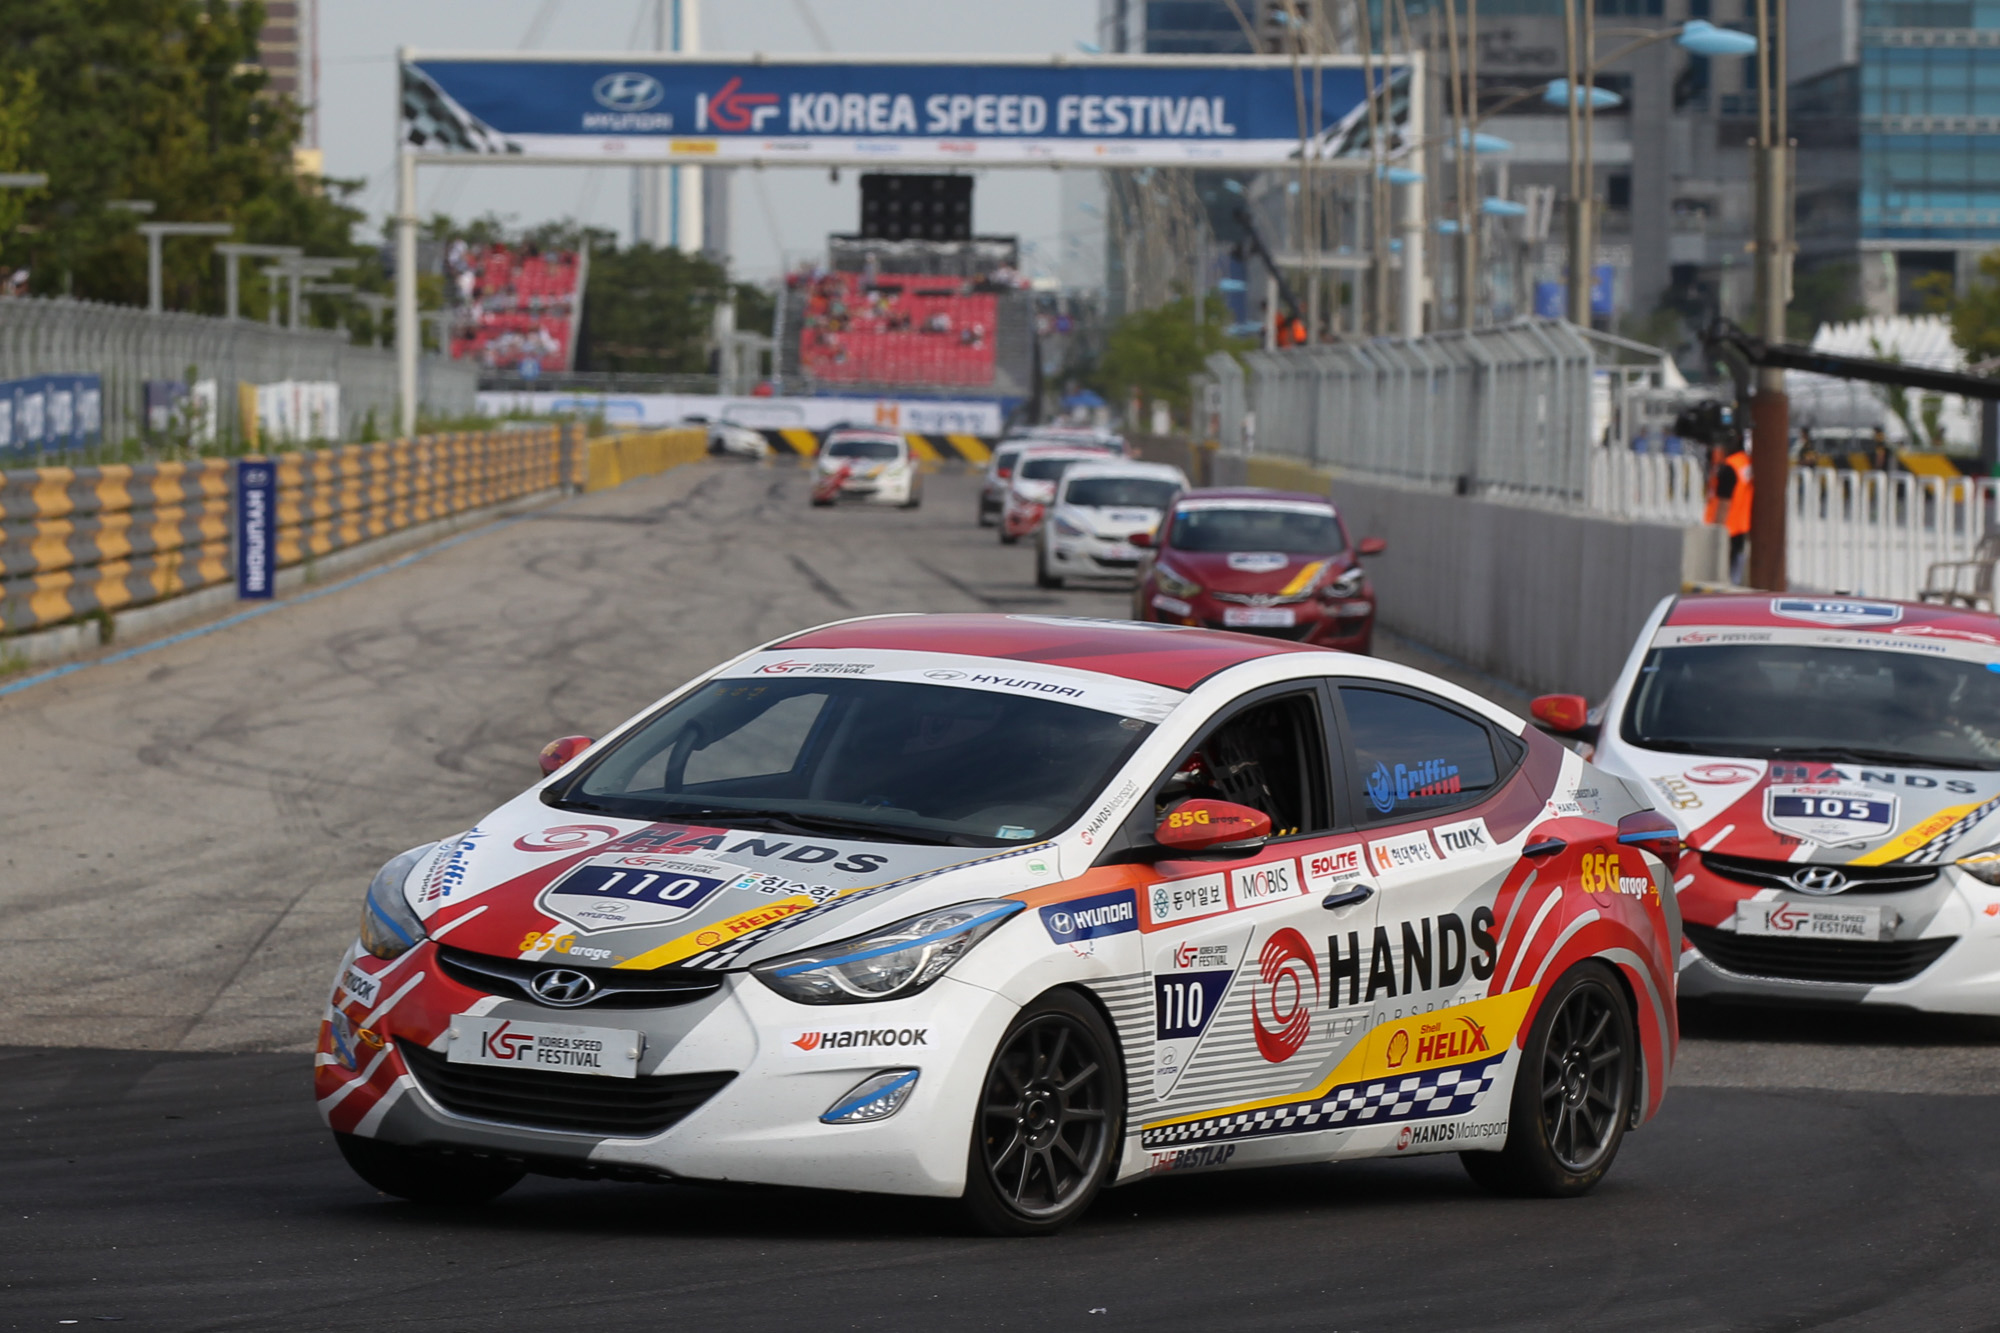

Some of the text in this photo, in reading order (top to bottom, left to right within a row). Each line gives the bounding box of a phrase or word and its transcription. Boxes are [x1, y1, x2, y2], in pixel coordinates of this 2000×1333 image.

[696, 76, 1236, 135] KSF KOREA SPEED FESTIVAL
[1857, 637, 1946, 652] HYUNDAI
[752, 659, 811, 674] KSF
[971, 674, 1086, 698] HYUNDAI
[1394, 758, 1459, 800] Griffin
[1771, 766, 1977, 794] HANDS
[1802, 798, 1870, 820] 105
[621, 829, 888, 874] HANDS
[1442, 827, 1485, 851] TUIX
[660, 863, 713, 874] FESTIVAL
[1311, 851, 1358, 875] SOLITE
[597, 871, 701, 901] 110
[760, 876, 838, 903] 힘수학
[1242, 867, 1289, 899] MOBIS
[1173, 885, 1222, 911] 동아일보
[576, 911, 627, 922] HYUNDAI
[728, 904, 808, 933] HELIX
[1073, 901, 1133, 929] HYUNDAI
[1765, 902, 1867, 931] KSF KOREA SPEED
[1812, 922, 1866, 935] FESTIVAL
[1173, 941, 1198, 968] KSF
[1198, 955, 1229, 967] FESTIVAL
[1328, 906, 1497, 1009] HANDS
[1163, 982, 1204, 1030] 110
[481, 1020, 603, 1060] KSF KOREA SPEED
[1420, 1022, 1442, 1034] Shell
[1415, 1020, 1490, 1064] HELIX
[537, 1049, 602, 1068] FESTIVAL
